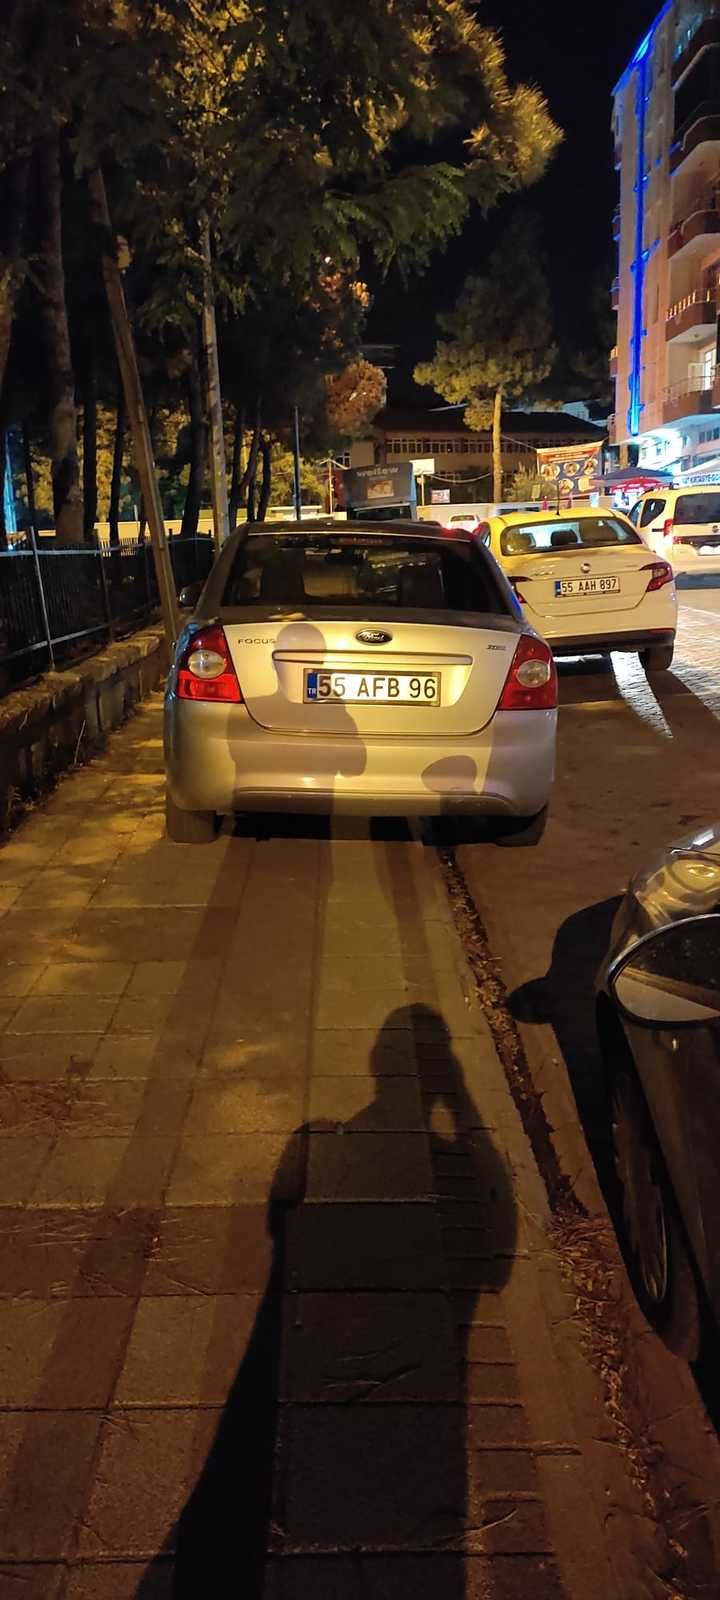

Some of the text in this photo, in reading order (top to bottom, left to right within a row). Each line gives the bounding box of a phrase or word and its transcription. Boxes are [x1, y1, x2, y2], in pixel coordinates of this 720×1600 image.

[562, 579, 617, 593] 55 AAH 897
[307, 676, 436, 699] TR 55 AFB 96
